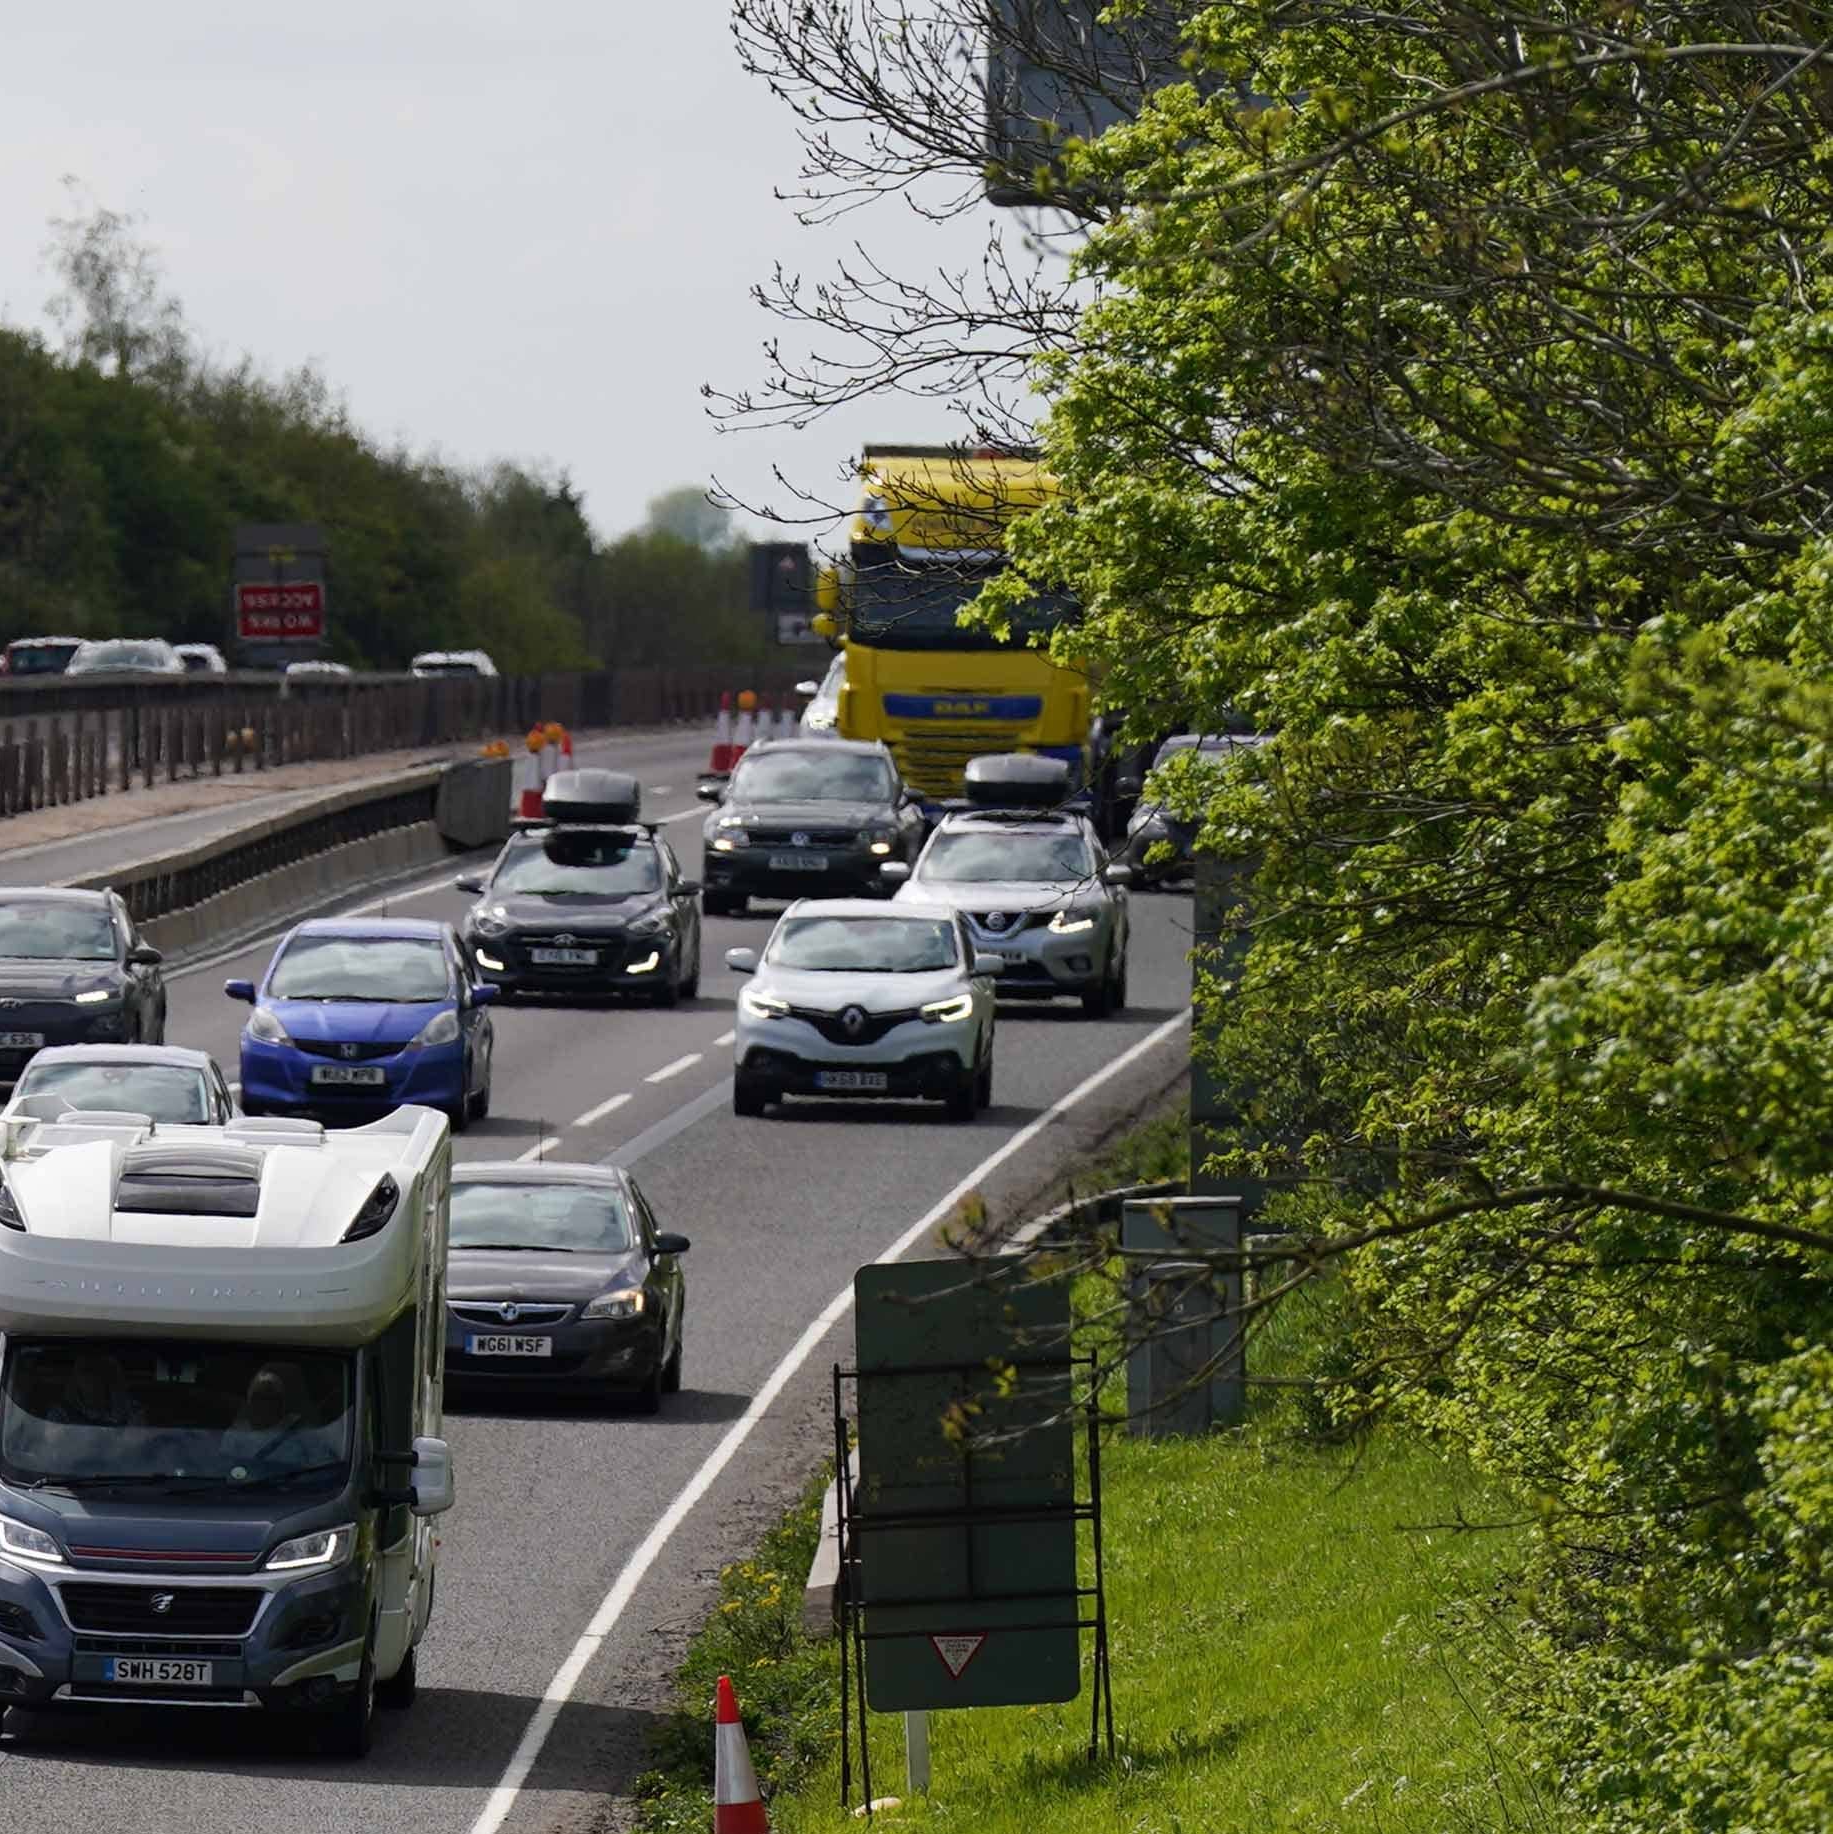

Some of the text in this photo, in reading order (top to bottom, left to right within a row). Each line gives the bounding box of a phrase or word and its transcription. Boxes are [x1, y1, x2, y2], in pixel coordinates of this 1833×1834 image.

[476, 1337, 545, 1353] WG61 WSF
[116, 1661, 209, 1684] SWH 528T
